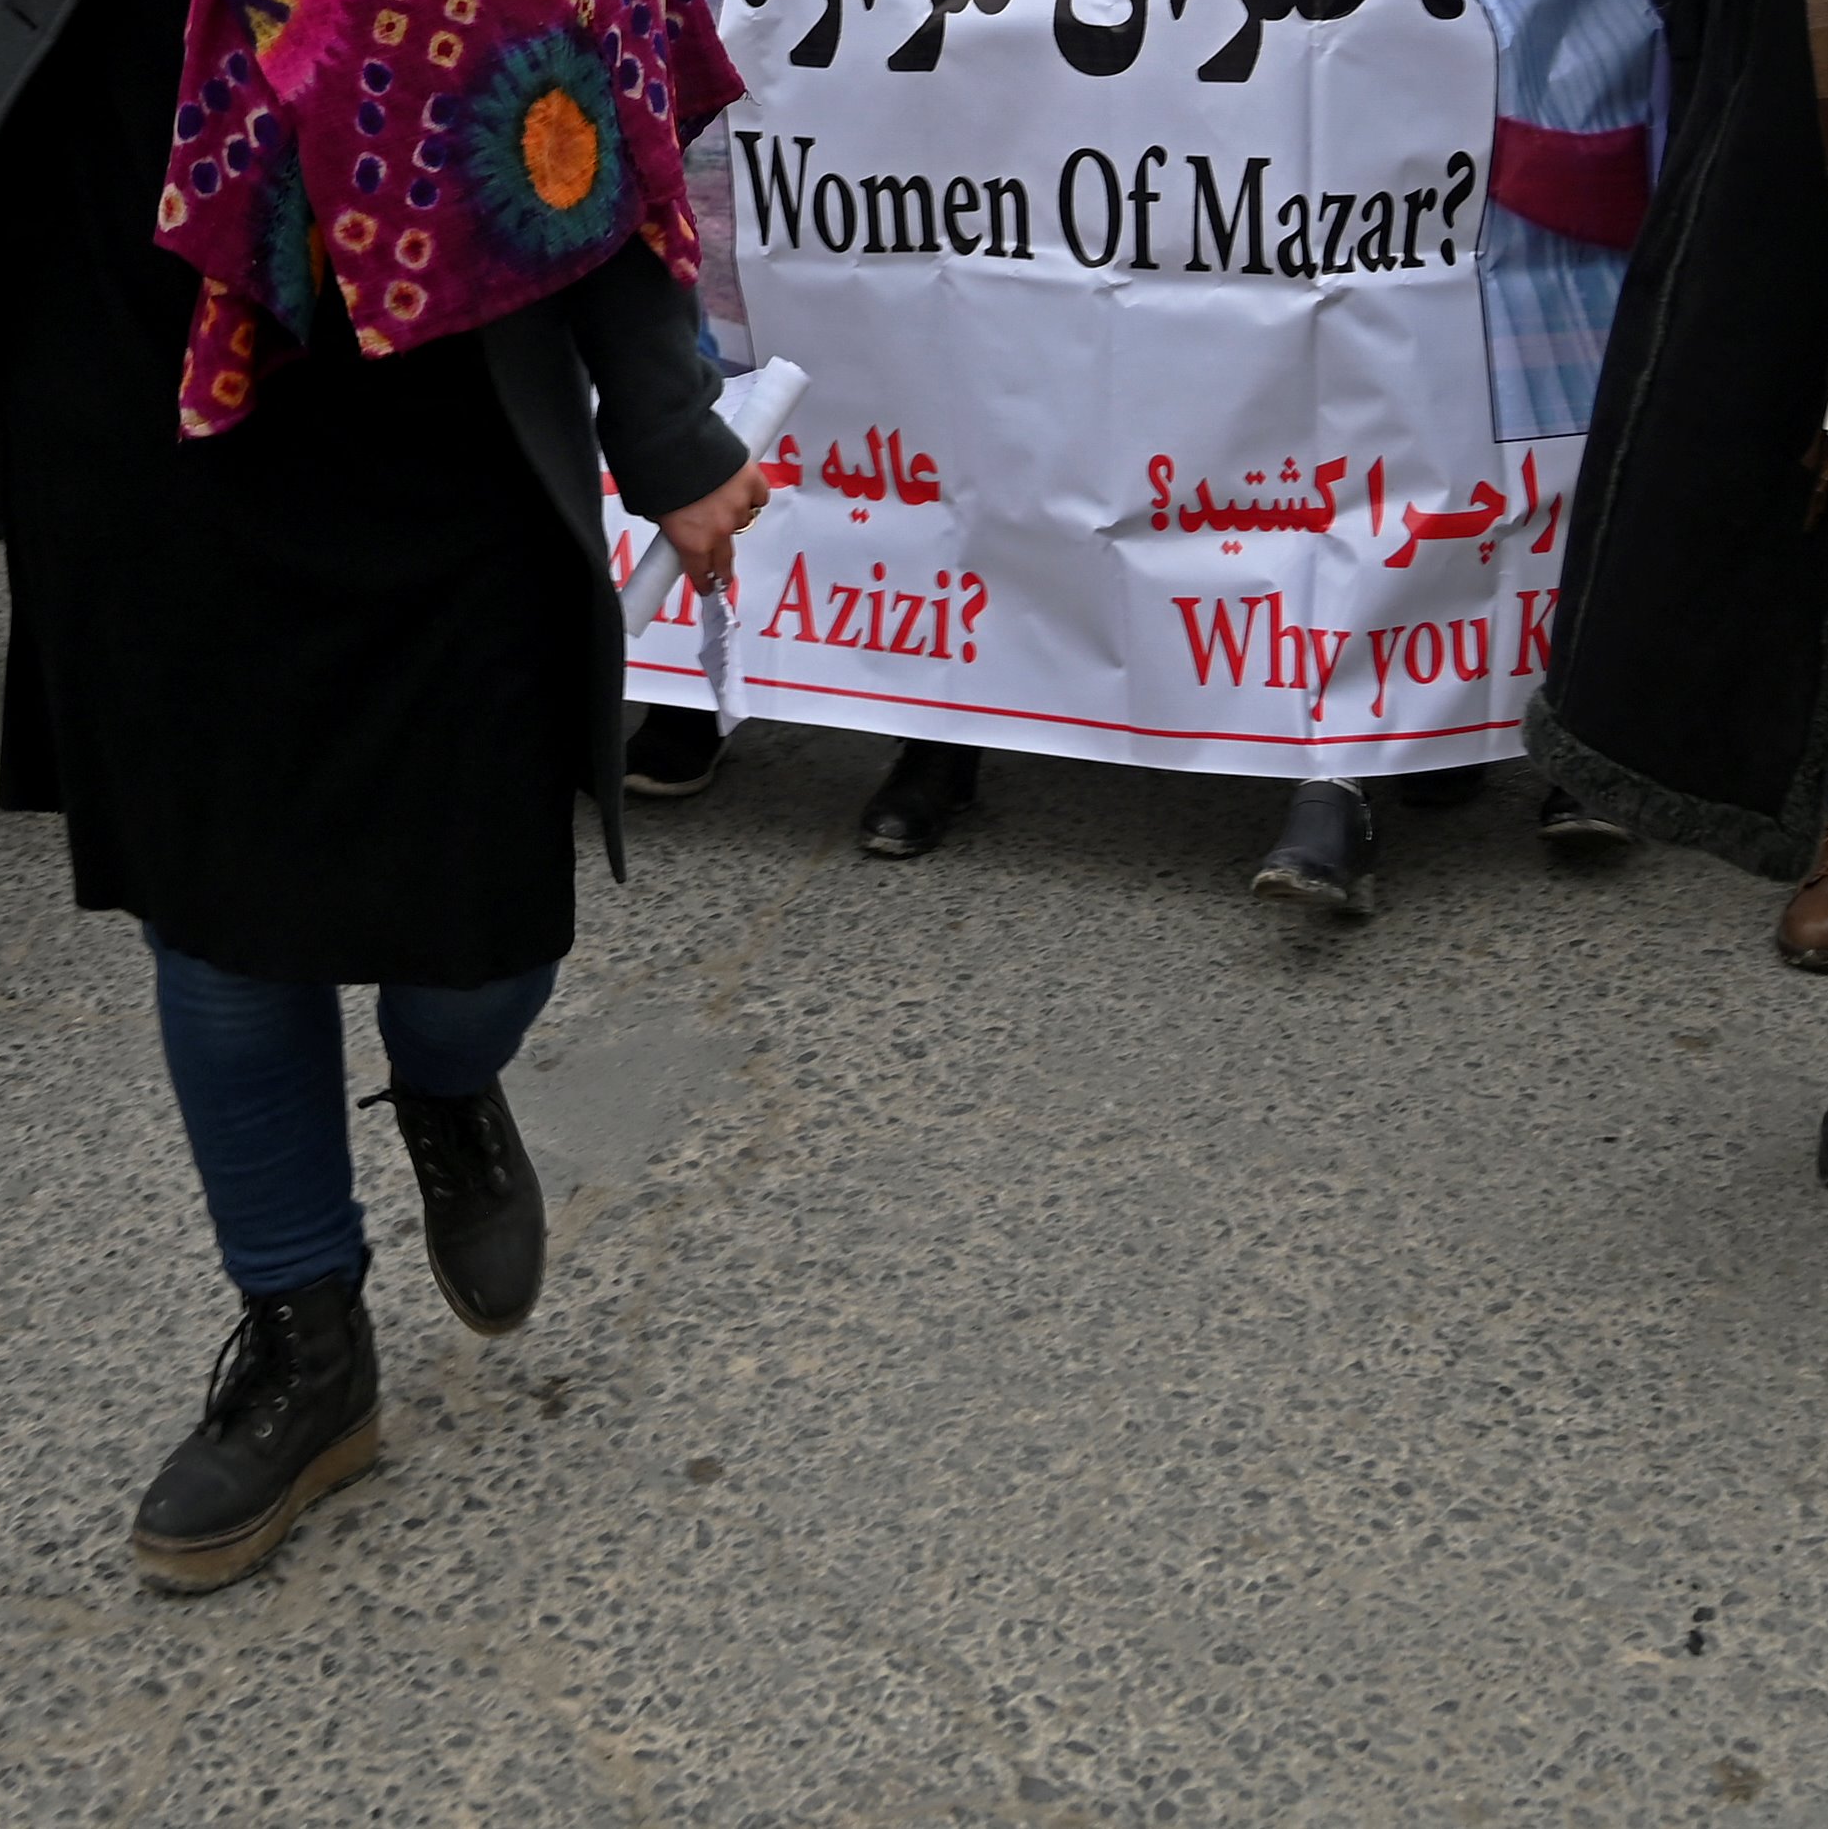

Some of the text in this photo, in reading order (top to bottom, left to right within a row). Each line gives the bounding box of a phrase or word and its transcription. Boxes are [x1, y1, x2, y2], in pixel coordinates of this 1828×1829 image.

[734, 130, 1479, 281] Women Of Mazar?
[820, 424, 943, 524] عالیه
[1147, 453, 1349, 556] کشتید؟
[1367, 453, 1509, 569] چرا
[759, 550, 990, 665] Azizi?
[1171, 590, 1352, 723] Why
[1367, 614, 1491, 719] you
